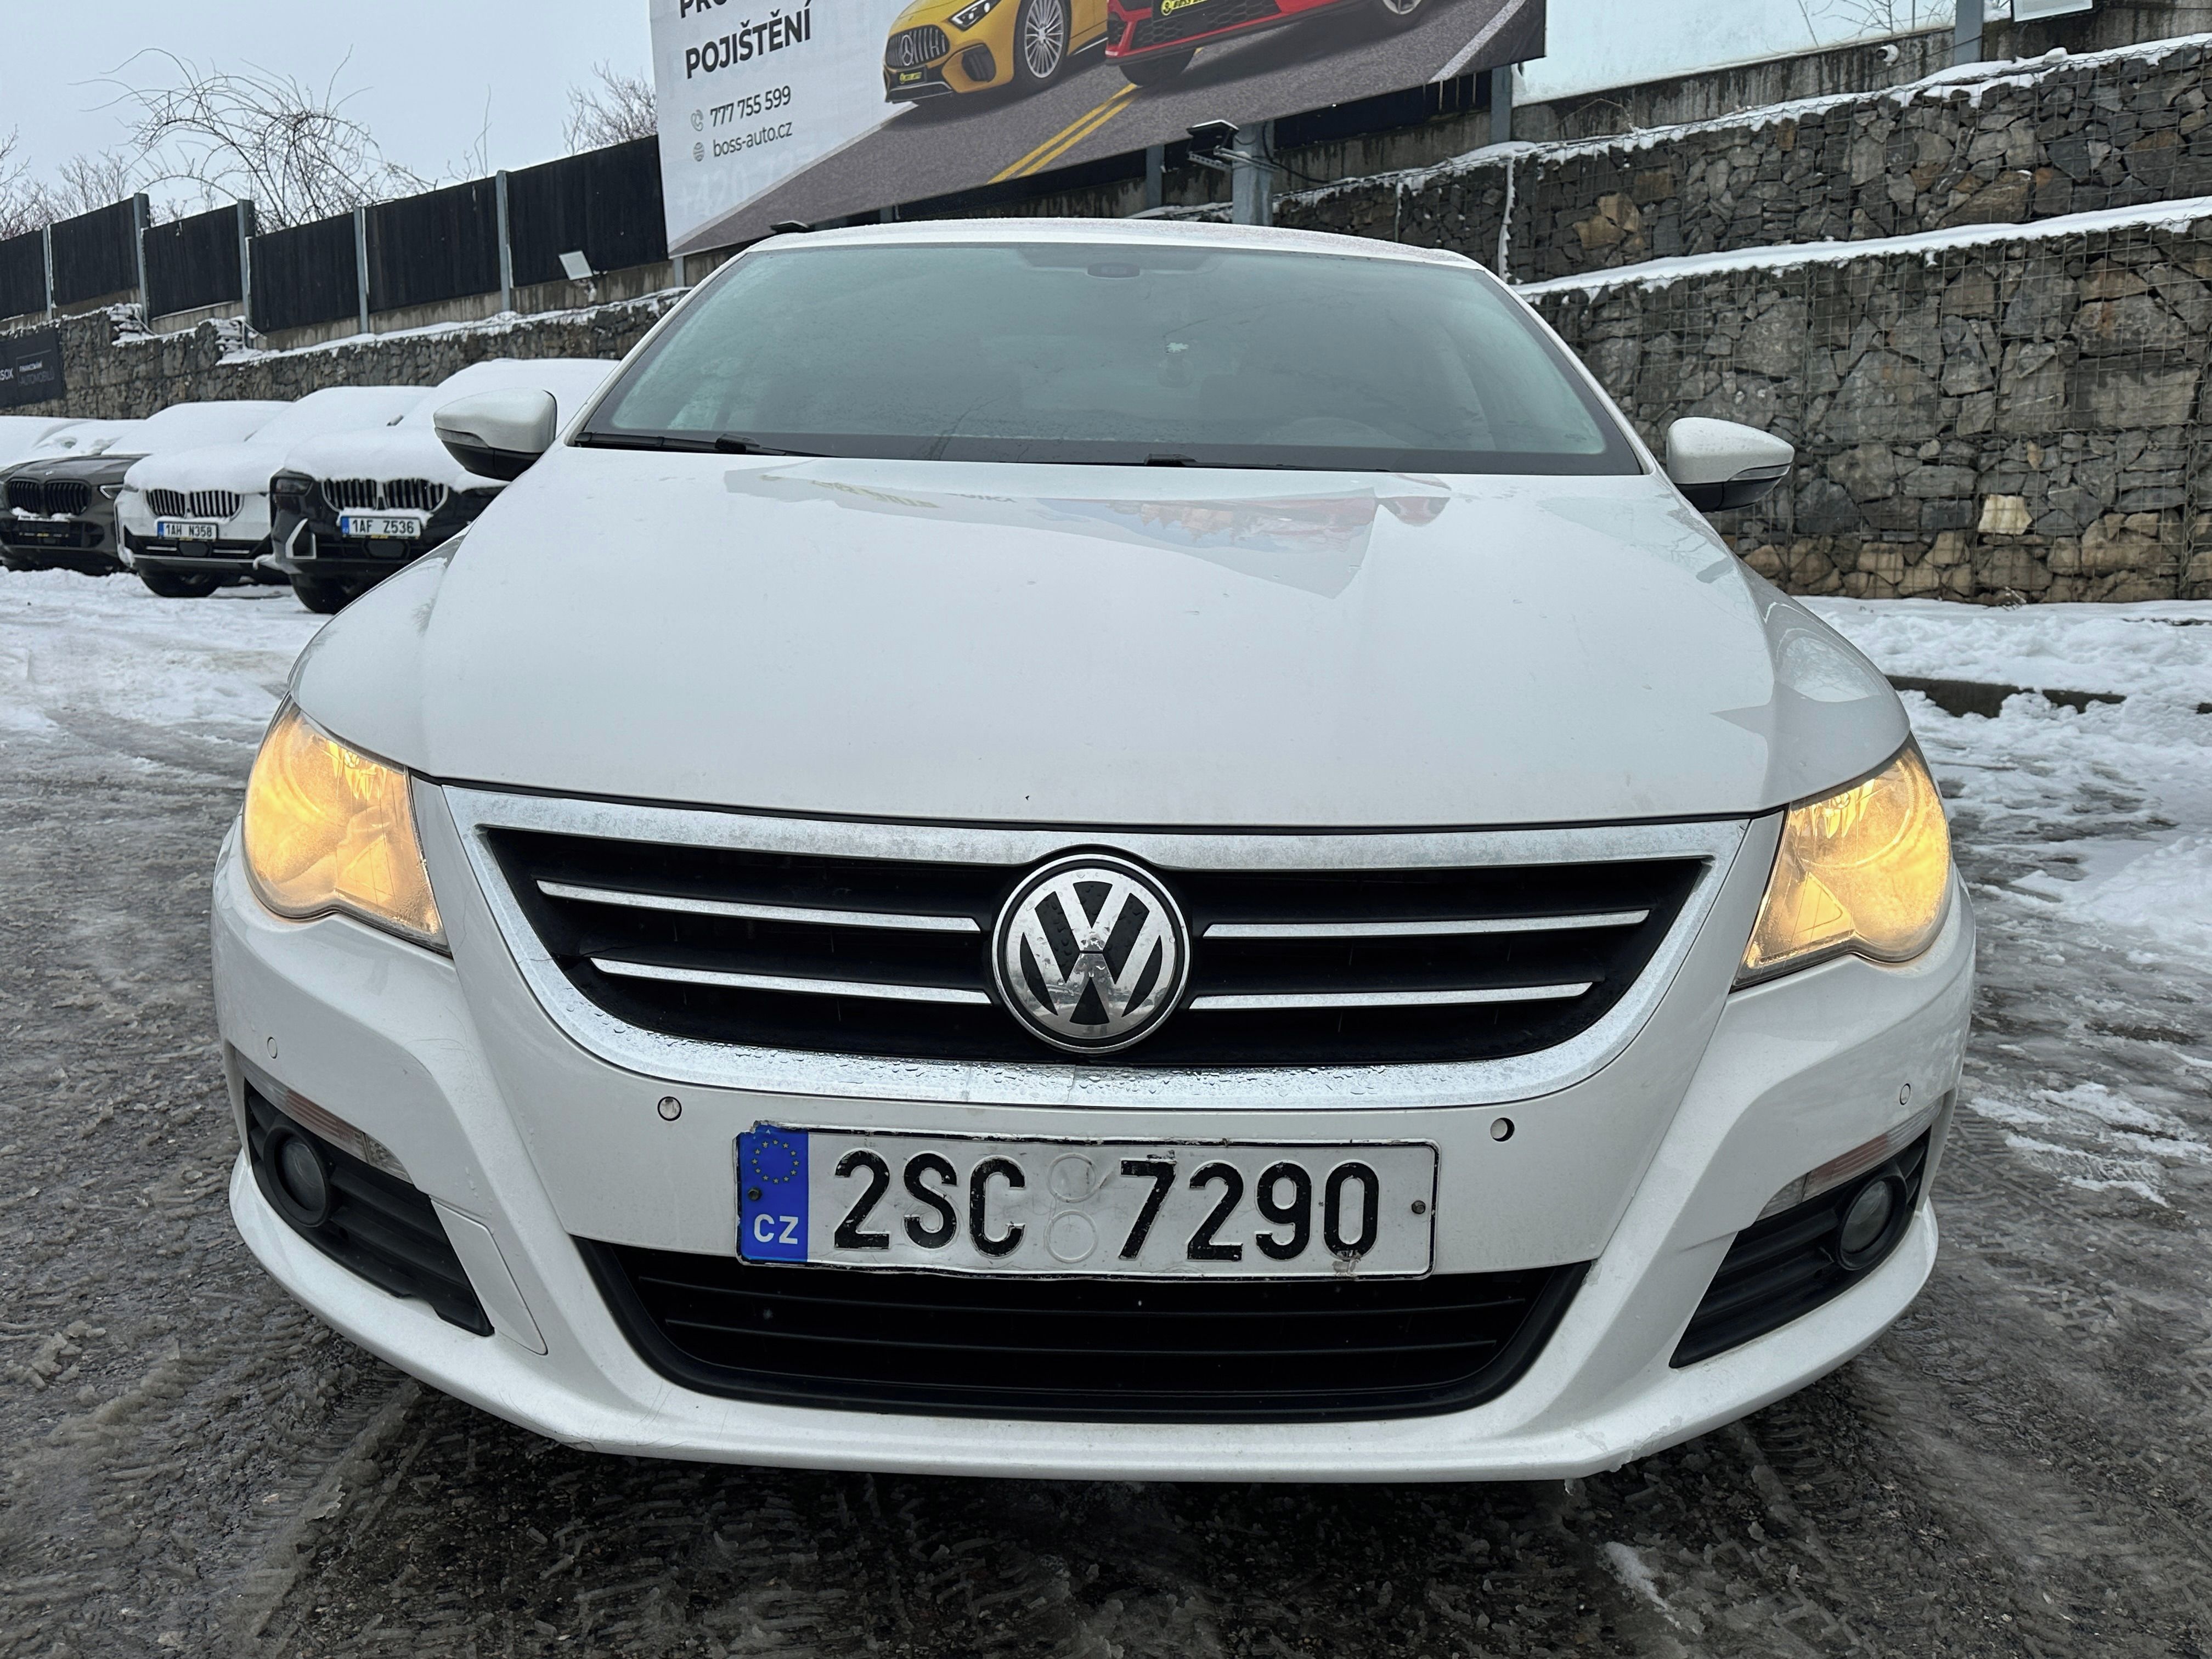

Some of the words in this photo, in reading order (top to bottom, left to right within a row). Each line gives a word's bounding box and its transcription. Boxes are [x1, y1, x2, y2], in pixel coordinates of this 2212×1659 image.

[685, 0, 811, 80] POJIŠTĚNÍ
[710, 103, 735, 127] 777
[737, 94, 761, 119] 755
[765, 85, 792, 111] 599
[713, 122, 793, 157] boss-auto.cz
[166, 524, 182, 535] 1AH
[189, 525, 212, 538] N358
[352, 520, 373, 532] 1AF
[382, 520, 414, 534] Z536
[833, 1148, 1026, 1259] 2SC
[1118, 1156, 1381, 1263] 7290
[753, 1213, 799, 1245] CZ
